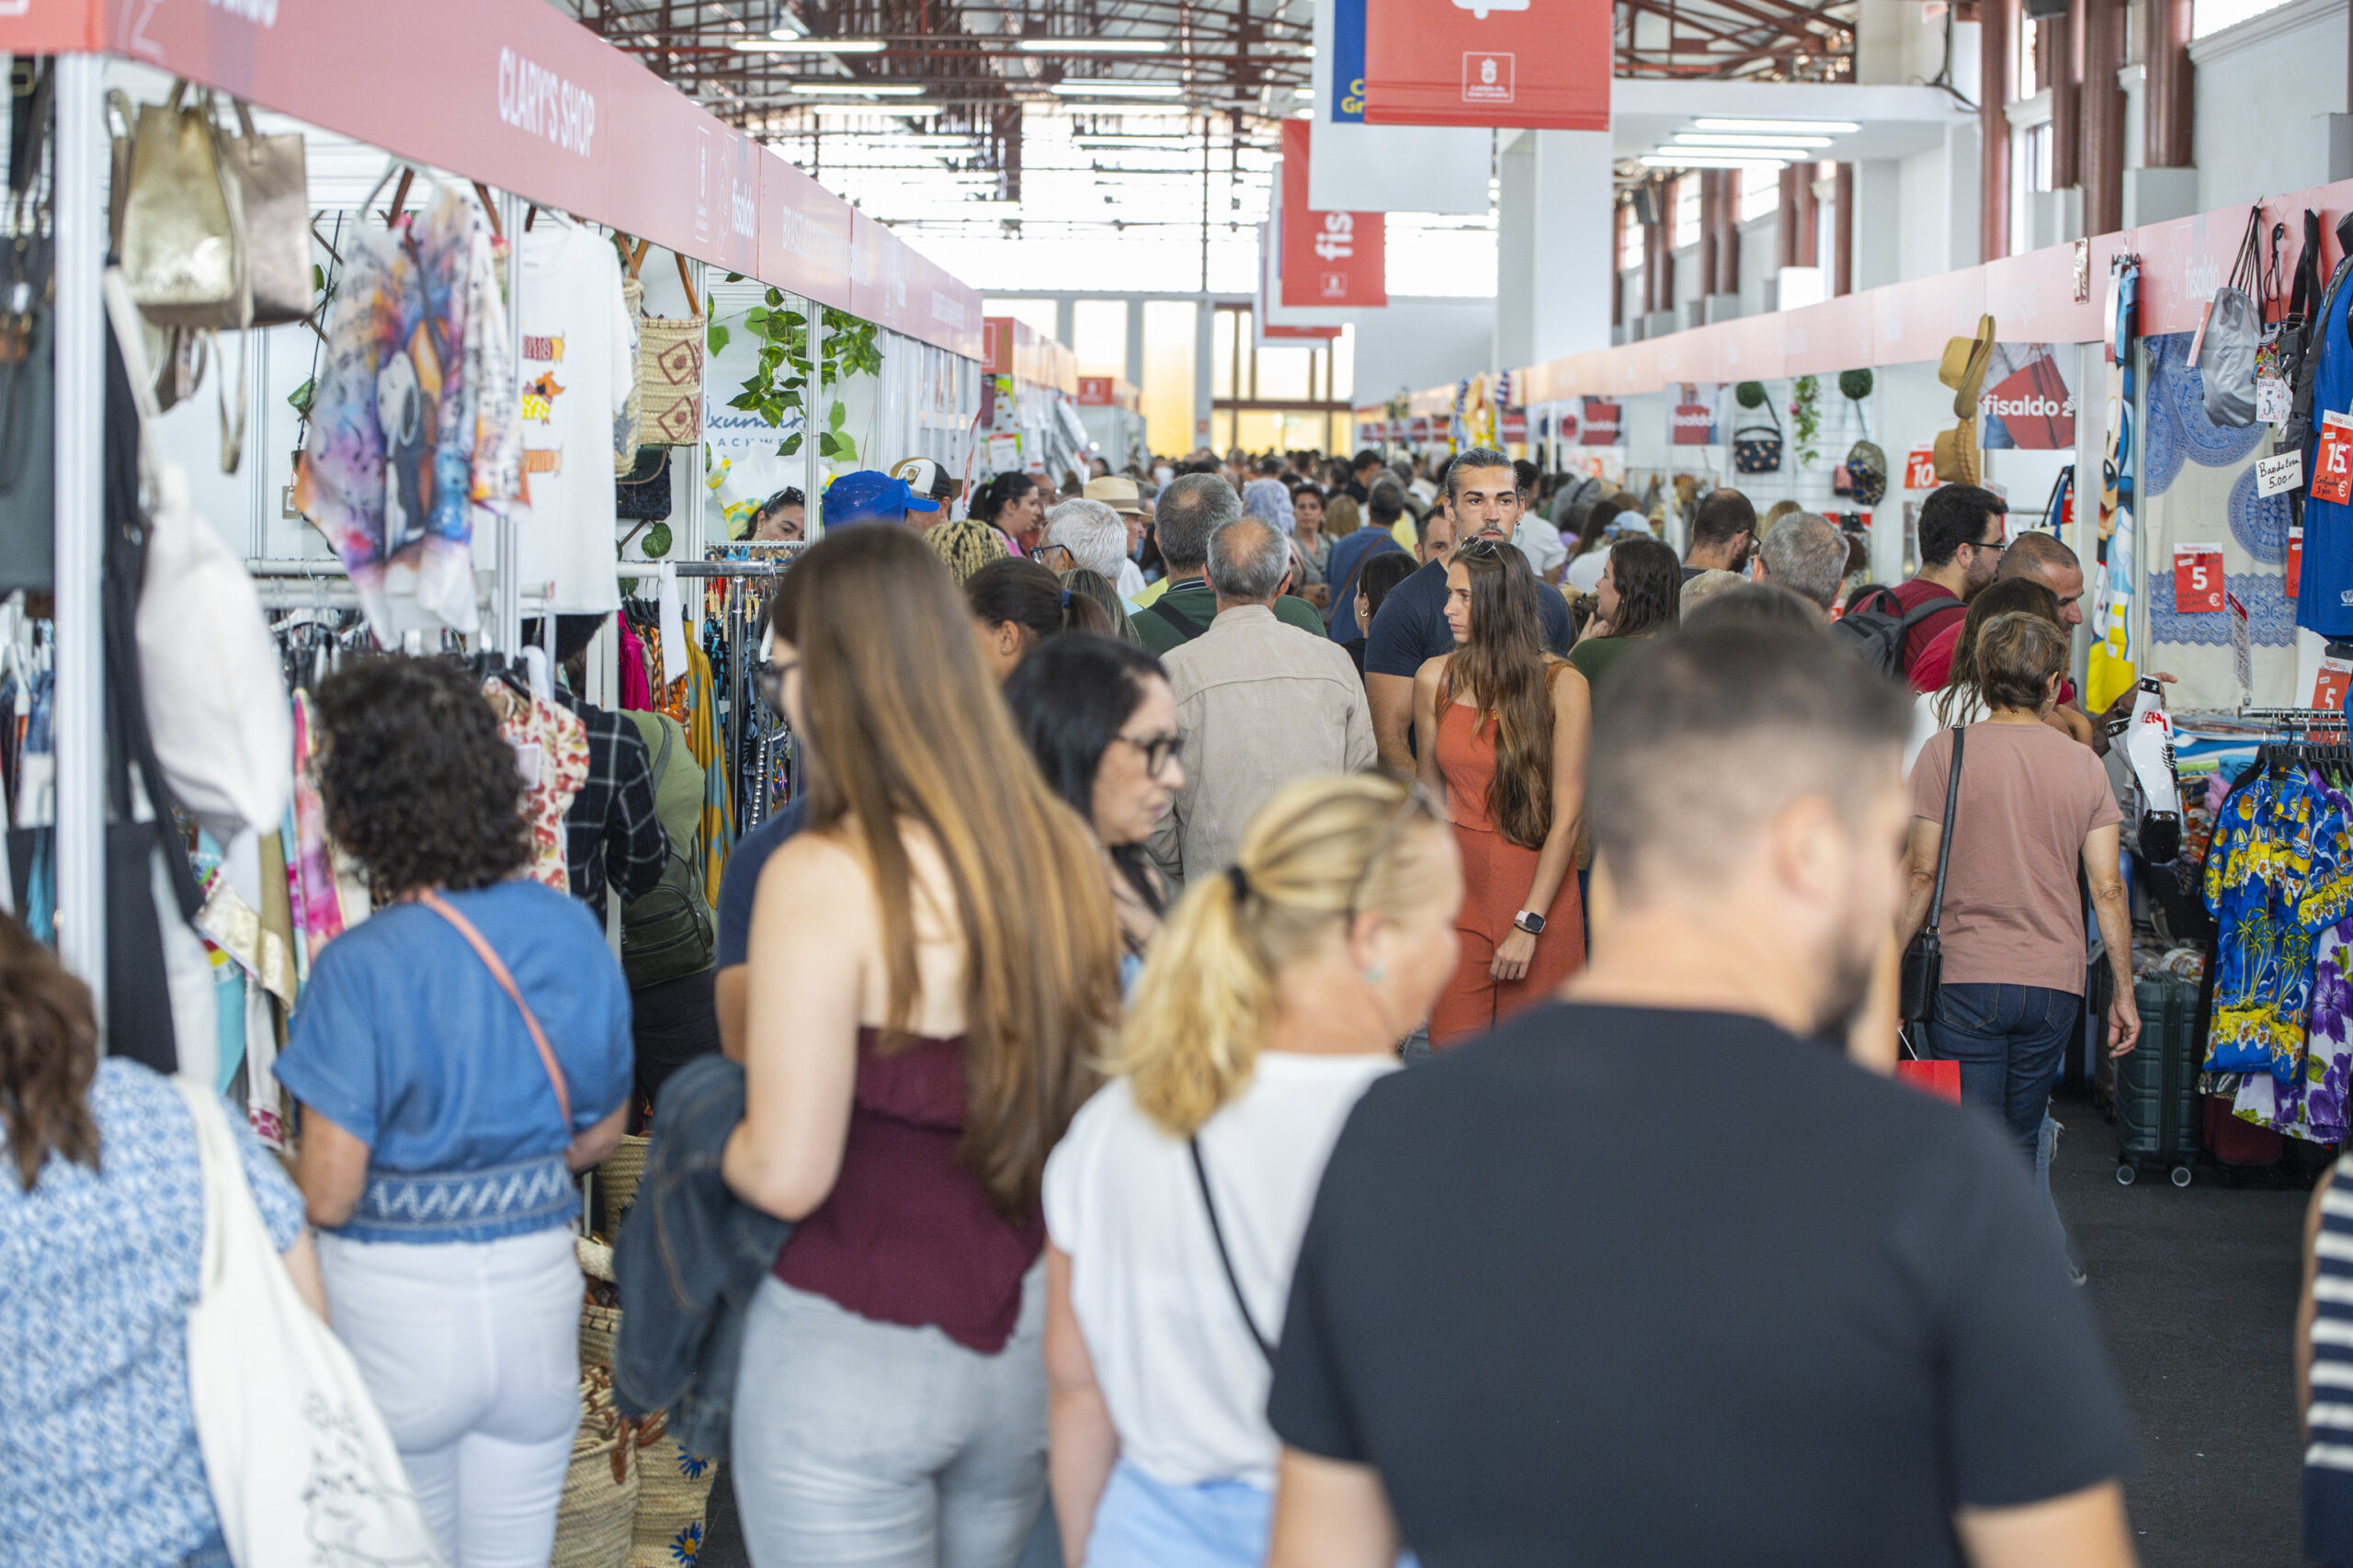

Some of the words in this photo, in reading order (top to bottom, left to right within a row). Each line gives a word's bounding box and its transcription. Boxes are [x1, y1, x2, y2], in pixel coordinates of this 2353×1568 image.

[498, 45, 559, 143] CLARY'S
[560, 78, 596, 158] SHOP
[1983, 394, 2059, 416] fisaldo
[1913, 463, 1935, 487] 10
[2337, 481, 2348, 497] €
[2192, 566, 2208, 590] 5
[2209, 593, 2221, 607] €
